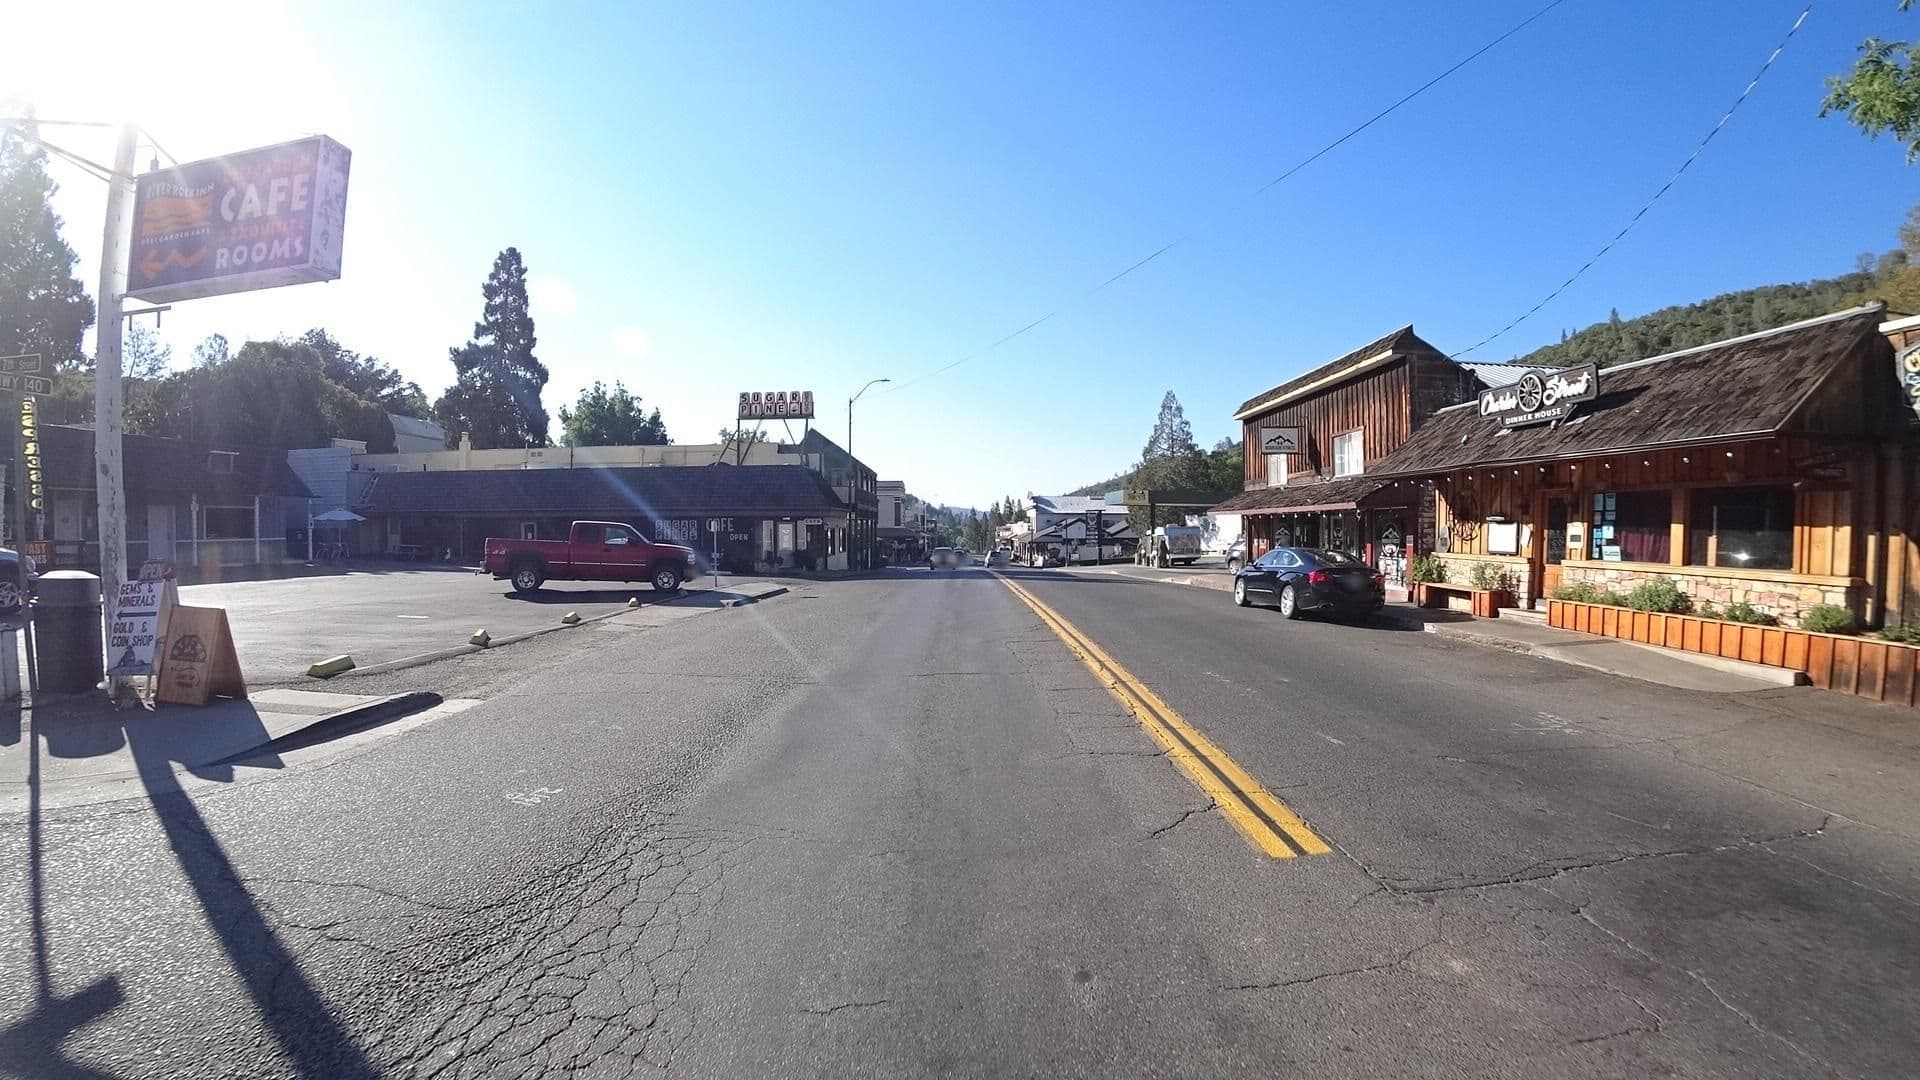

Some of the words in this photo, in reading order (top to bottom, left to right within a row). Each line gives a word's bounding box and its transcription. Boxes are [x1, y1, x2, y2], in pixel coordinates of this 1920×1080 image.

[220, 174, 310, 222] CAFE
[215, 237, 303, 270] ROOMS
[24, 378, 42, 392] 140
[740, 392, 798, 402] SUGAR
[741, 404, 785, 413] PINE
[1505, 413, 1533, 425] DINNER
[1534, 407, 1562, 418] HOUSE
[655, 520, 697, 530] SUGAR
[706, 517, 734, 532] CAFE
[729, 533, 749, 541] OPEN
[120, 582, 142, 595] GEMS
[117, 594, 156, 608] MINERALS
[113, 622, 134, 634] GOLD
[111, 635, 129, 648] COIN
[132, 635, 154, 648] SHOP
